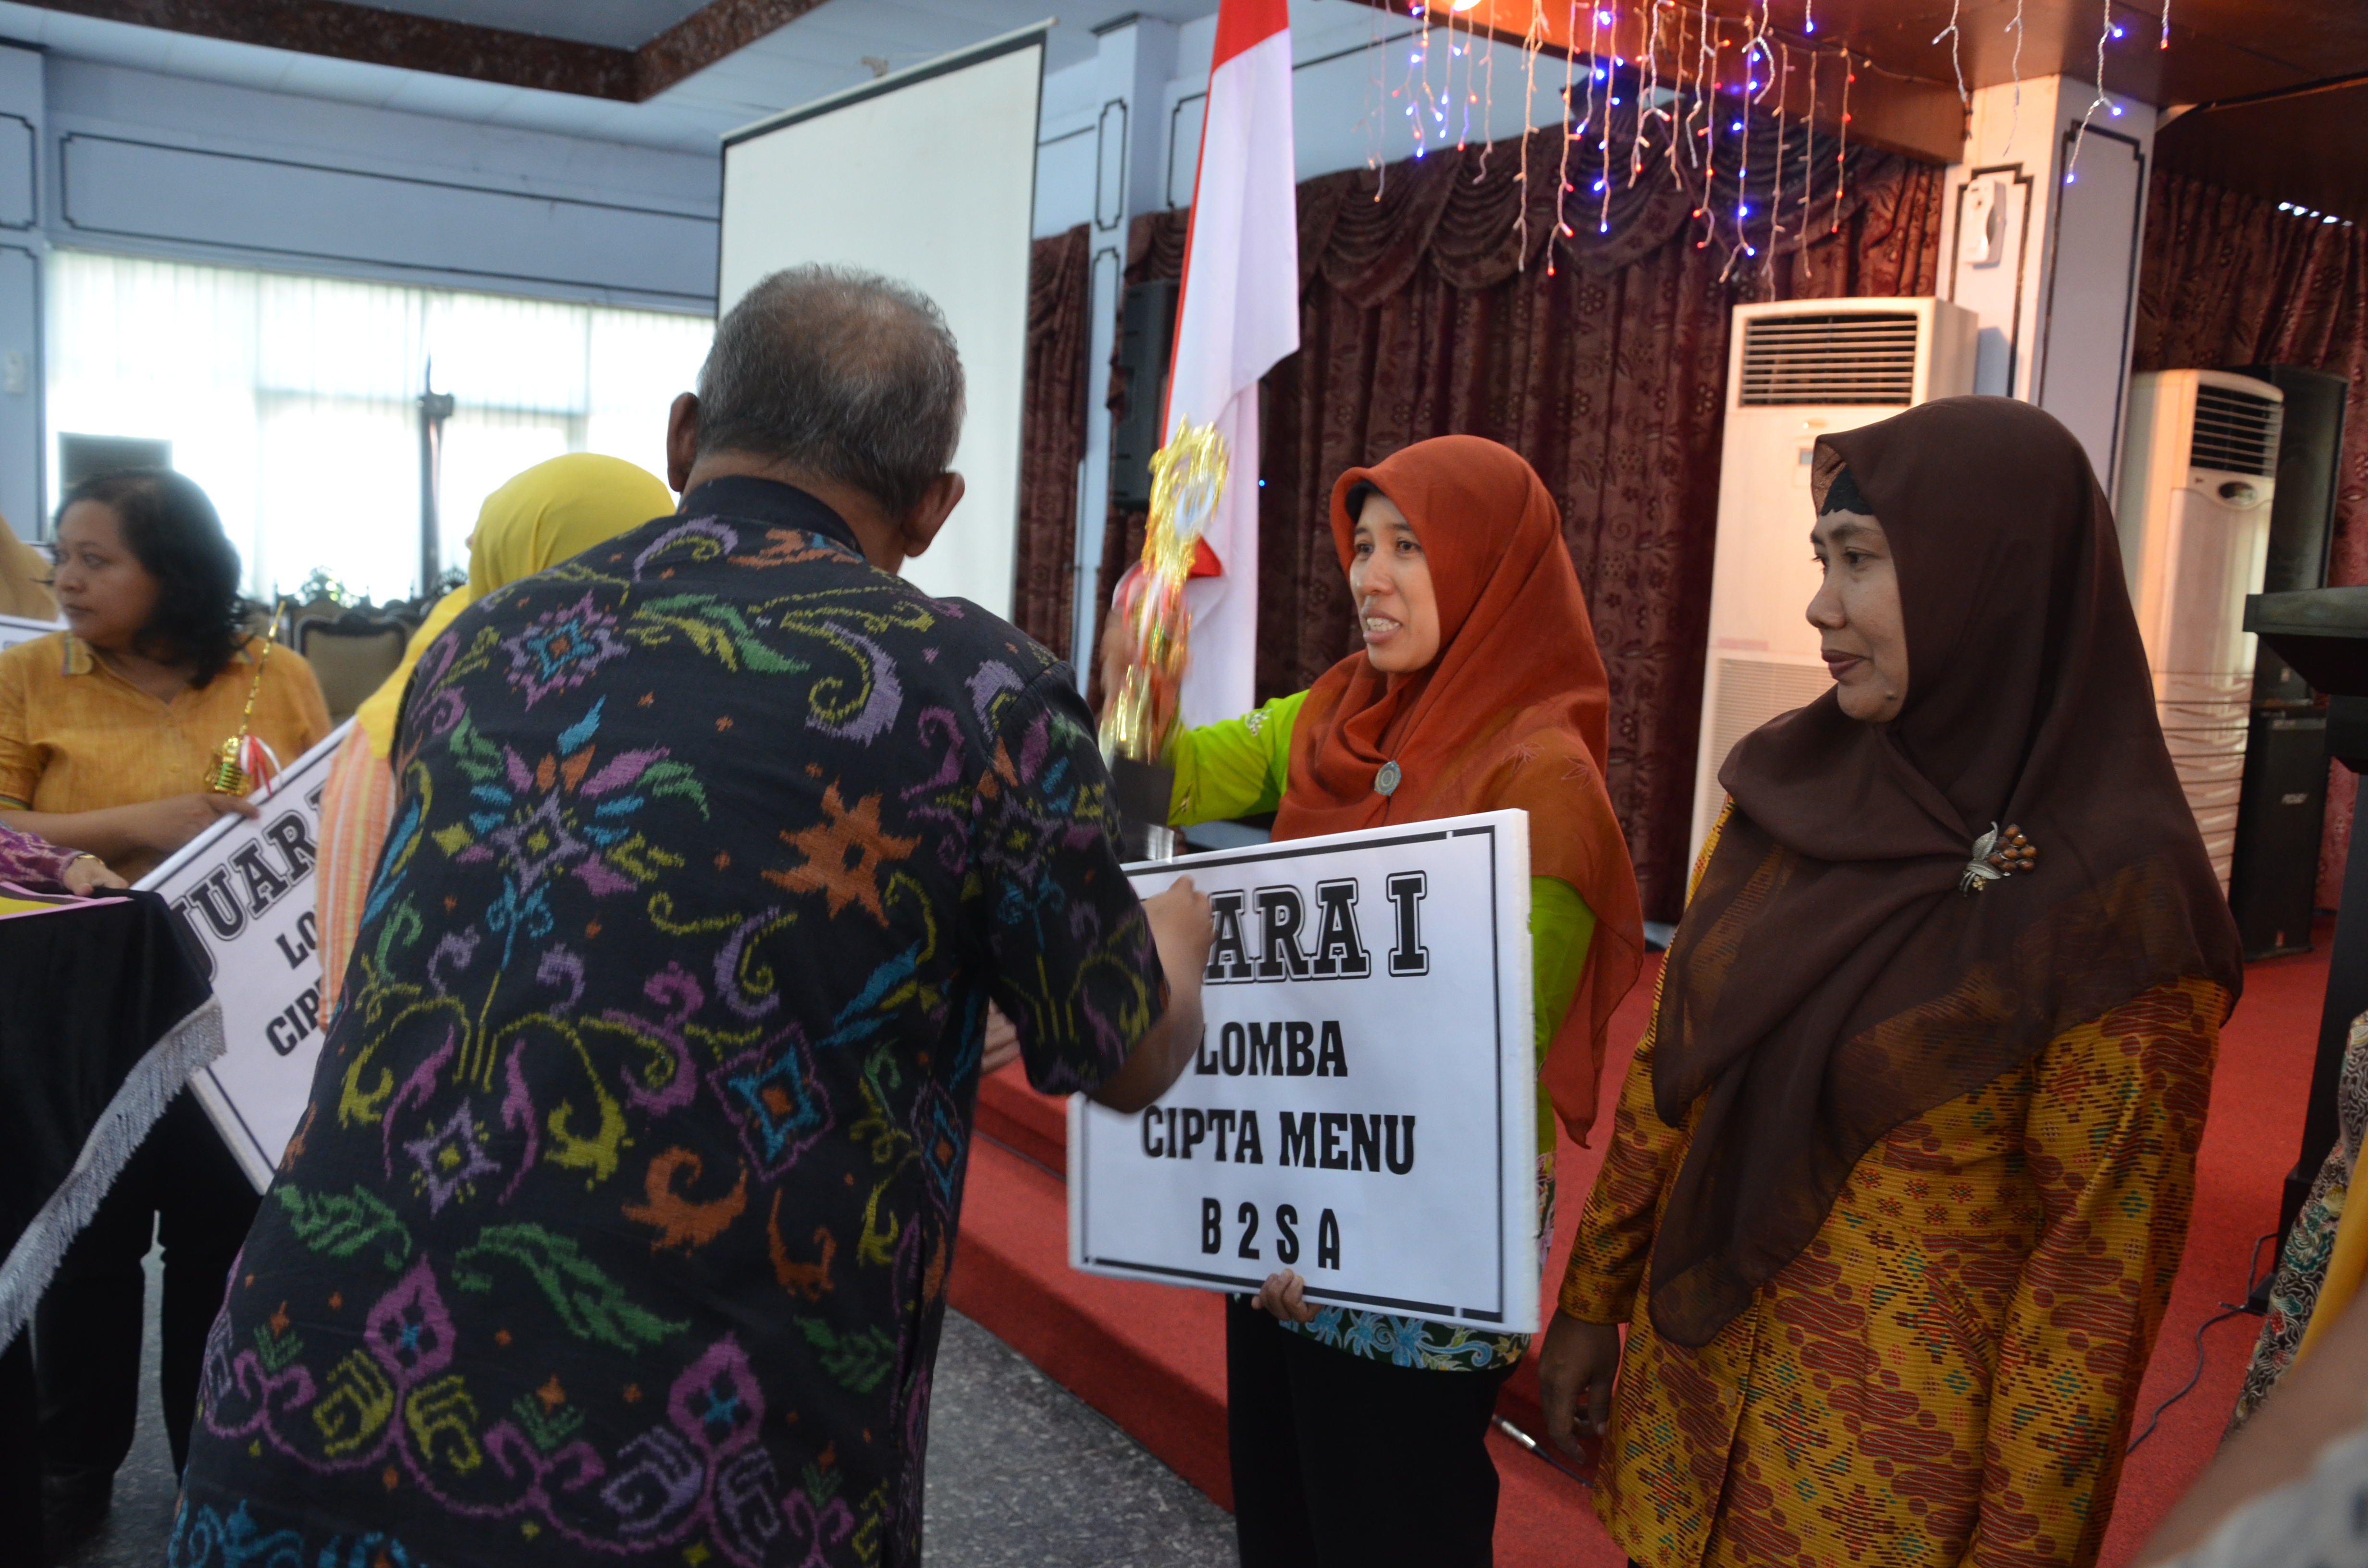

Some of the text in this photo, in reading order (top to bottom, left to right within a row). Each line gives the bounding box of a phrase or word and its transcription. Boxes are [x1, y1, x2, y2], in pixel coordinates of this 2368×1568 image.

[168, 778, 325, 981] UAR
[1203, 870, 1429, 985] ARA I
[266, 976, 322, 1056] CIP
[1195, 1020, 1348, 1077] LOMBA
[1142, 1104, 1416, 1175] CIPTA MENU
